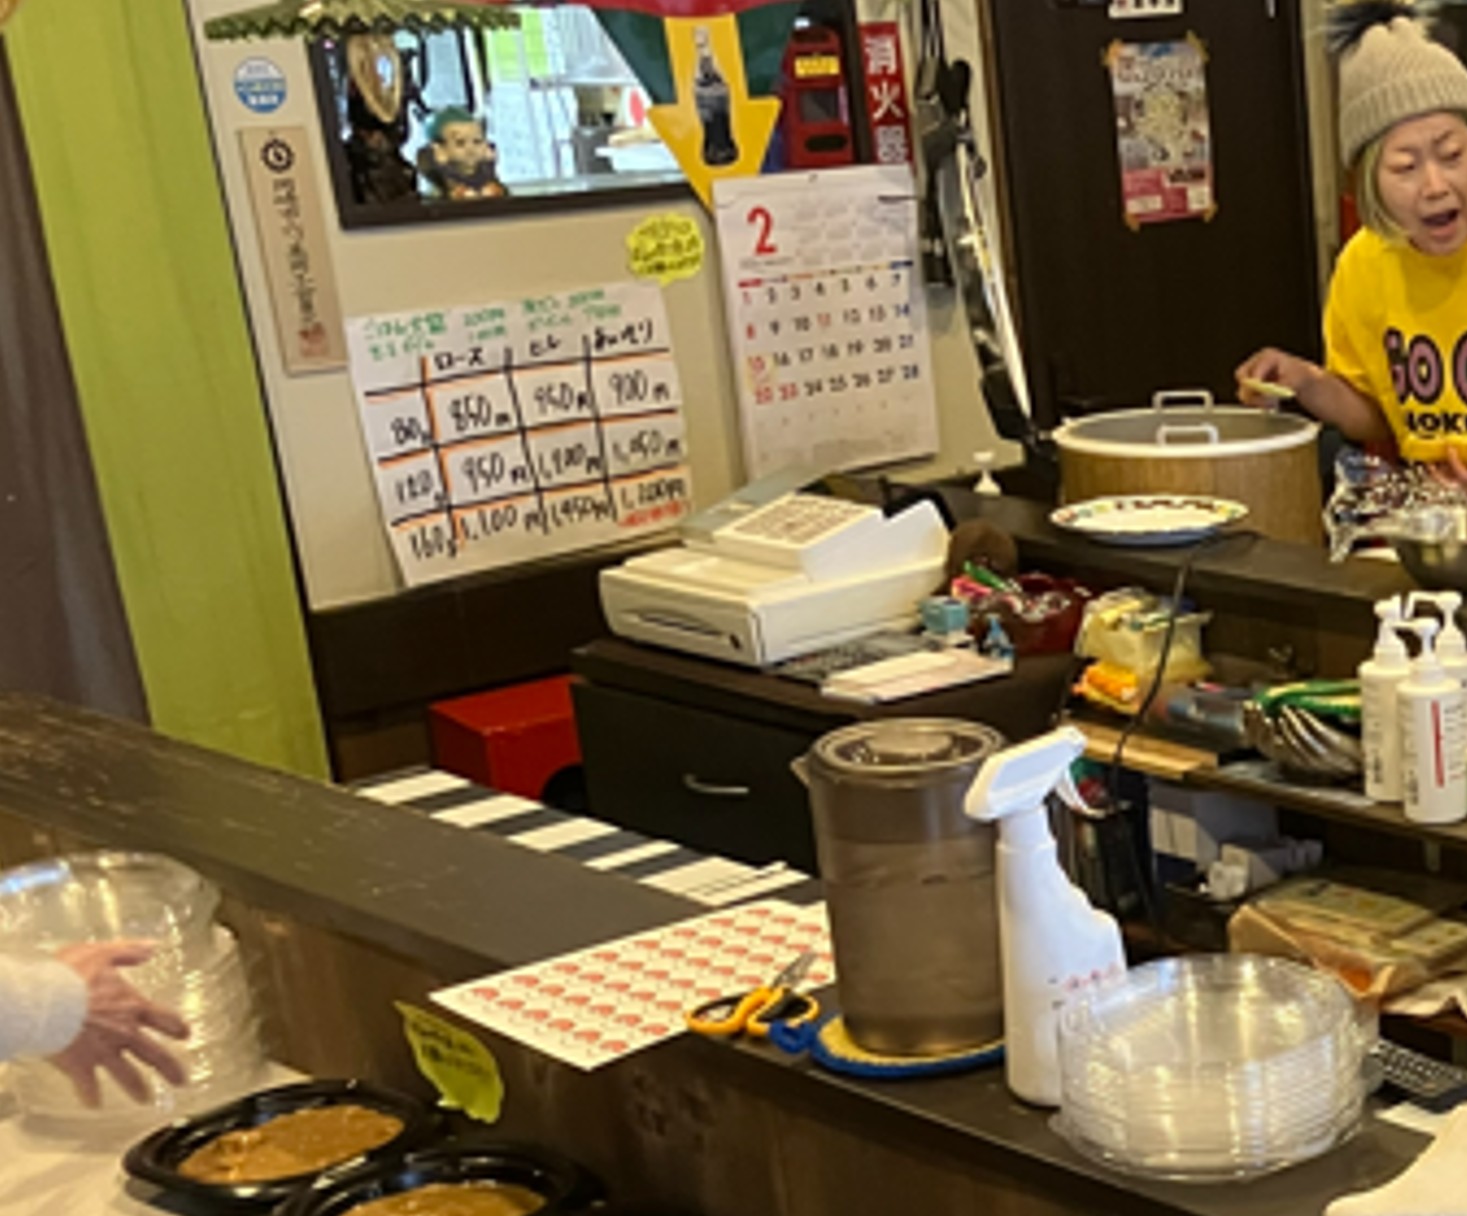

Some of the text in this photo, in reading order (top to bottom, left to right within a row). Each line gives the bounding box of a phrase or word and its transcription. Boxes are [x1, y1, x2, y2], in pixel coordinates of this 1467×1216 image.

[864, 35, 908, 163] 消火器
[747, 206, 778, 256] 2
[434, 347, 486, 370] ロース
